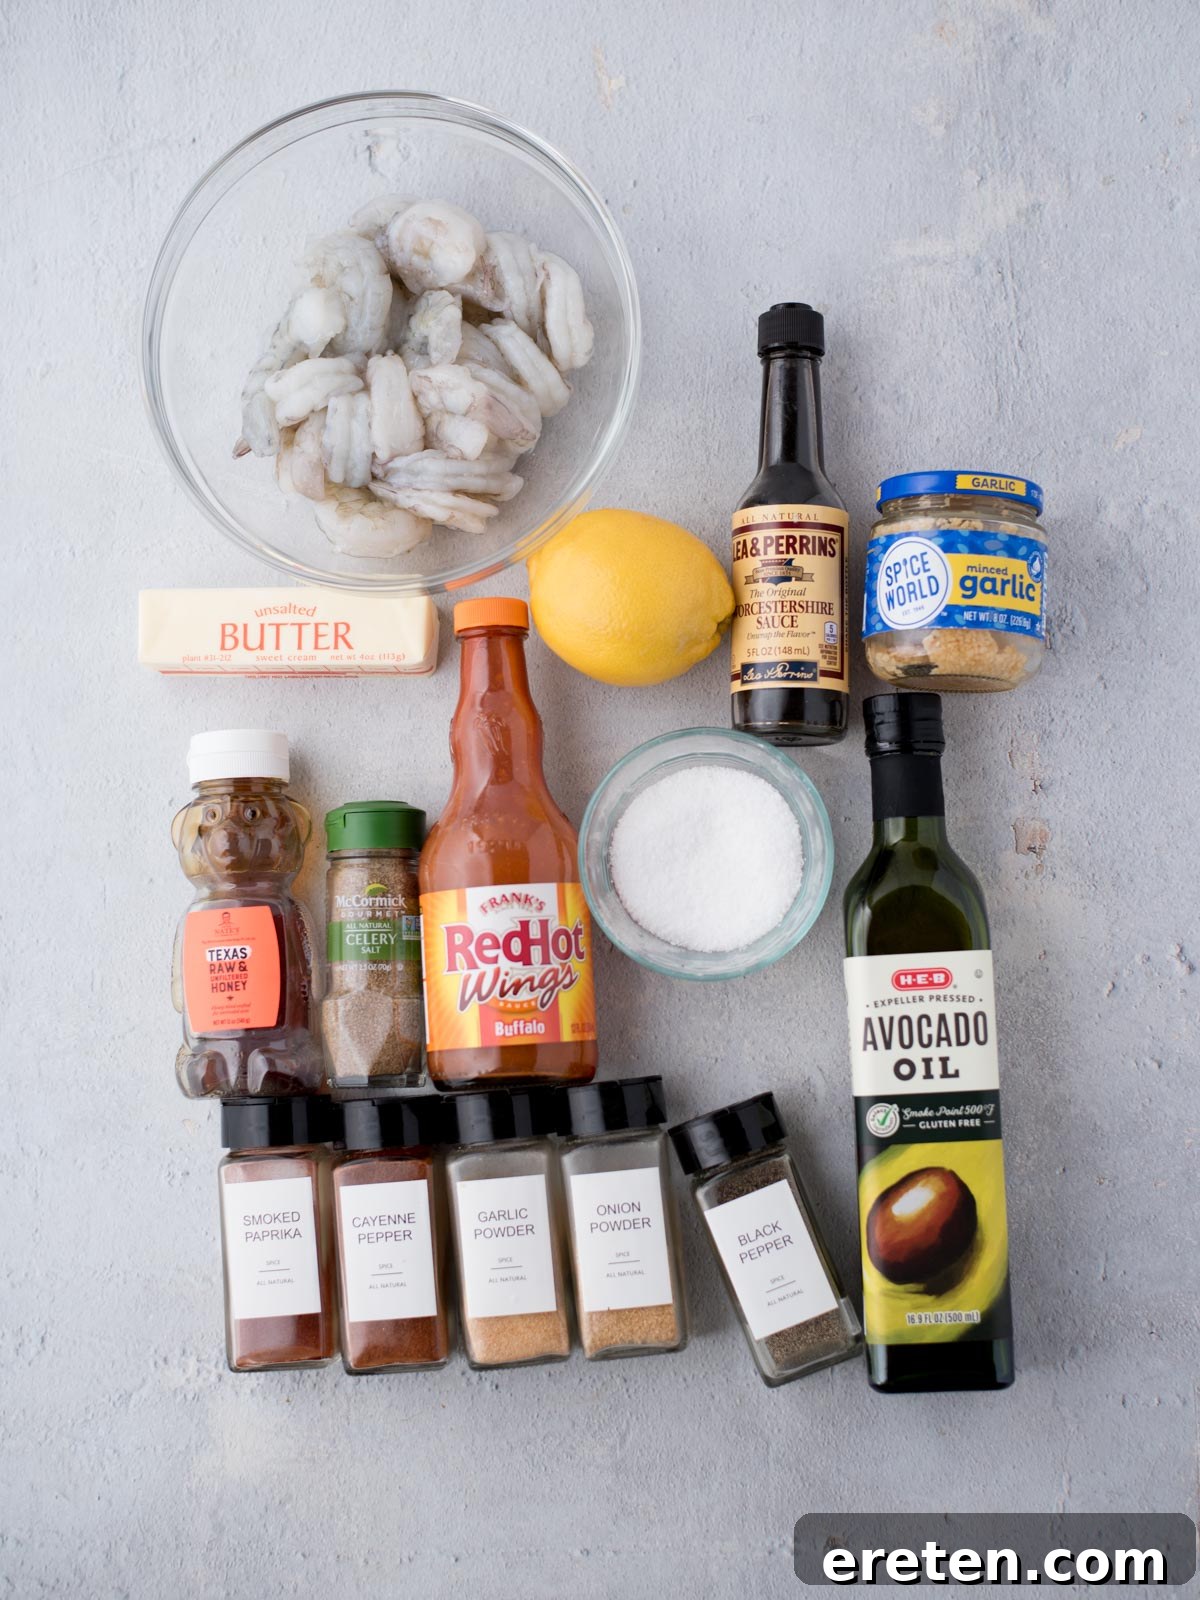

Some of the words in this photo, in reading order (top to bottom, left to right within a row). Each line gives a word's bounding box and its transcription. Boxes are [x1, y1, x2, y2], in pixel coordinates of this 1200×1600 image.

[971, 477, 1016, 492] GARLIC
[741, 515, 755, 525] ALL
[762, 512, 819, 521] NATURAL
[884, 551, 931, 587] SPICE
[966, 563, 1008, 576] minced
[750, 590, 764, 599] The
[766, 588, 807, 599] Original
[885, 575, 940, 612] WORLD
[959, 574, 1036, 602] garlic
[254, 602, 317, 618] unsalted
[756, 615, 799, 629] SAUCE
[963, 611, 977, 622] NET
[979, 613, 992, 623] WT.
[993, 613, 999, 623] 8
[1000, 614, 1009, 625] OZ.
[786, 630, 811, 638] Flavor
[829, 625, 834, 633] 5
[220, 621, 354, 652] BUTTER
[182, 655, 201, 663] plant
[255, 654, 283, 662] sweet
[378, 652, 406, 662] (113g)
[747, 649, 751, 657] 5
[752, 648, 760, 657] FL
[760, 647, 773, 656] OZ
[774, 647, 793, 657] (148
[794, 648, 811, 657] mL)
[335, 895, 408, 909] McCormick
[480, 892, 546, 915] FRANK'S
[341, 910, 400, 918] GOURMET
[346, 933, 397, 945] CELERY
[444, 919, 585, 972] RedHot
[208, 947, 248, 962] TEXAS
[361, 946, 381, 954] SALT
[209, 962, 236, 974] RAW
[238, 961, 249, 972] &
[210, 973, 249, 982] UNFILTERED
[211, 980, 247, 993] HONEY
[458, 963, 578, 1012] Wings
[873, 996, 925, 1008] EXPELLER
[929, 995, 975, 1003] PRESSED
[494, 1020, 545, 1036] Buffalo
[862, 1011, 989, 1051] AVOCADO
[893, 1056, 960, 1081] OIL
[902, 1107, 934, 1120] Smoke
[935, 1105, 963, 1116] Point
[918, 1121, 956, 1129] GLUTEN
[958, 1119, 981, 1127] FREE
[477, 1208, 529, 1222] GARLIC
[596, 1201, 641, 1216] ONION
[243, 1211, 301, 1227] SMOKED
[352, 1212, 416, 1228] CAYENNE
[590, 1217, 652, 1233] POWDER
[245, 1228, 302, 1243] PAPRIKA
[358, 1229, 413, 1244] PEPPER
[474, 1224, 535, 1240] POWDER
[738, 1220, 782, 1247] BLACK
[739, 1234, 794, 1264] PEPPER
[268, 1277, 295, 1285] NATURAL
[500, 1275, 527, 1283] NATURAL
[617, 1270, 645, 1278] NATURAL
[770, 1275, 784, 1285] SPICE
[380, 1281, 407, 1289] NATURAL
[767, 1299, 777, 1307] ALL
[777, 1289, 804, 1303] NATURAL
[908, 1314, 922, 1324] 16.9
[924, 1314, 932, 1323] FL
[934, 1313, 943, 1323] OZ
[945, 1312, 963, 1323] (500
